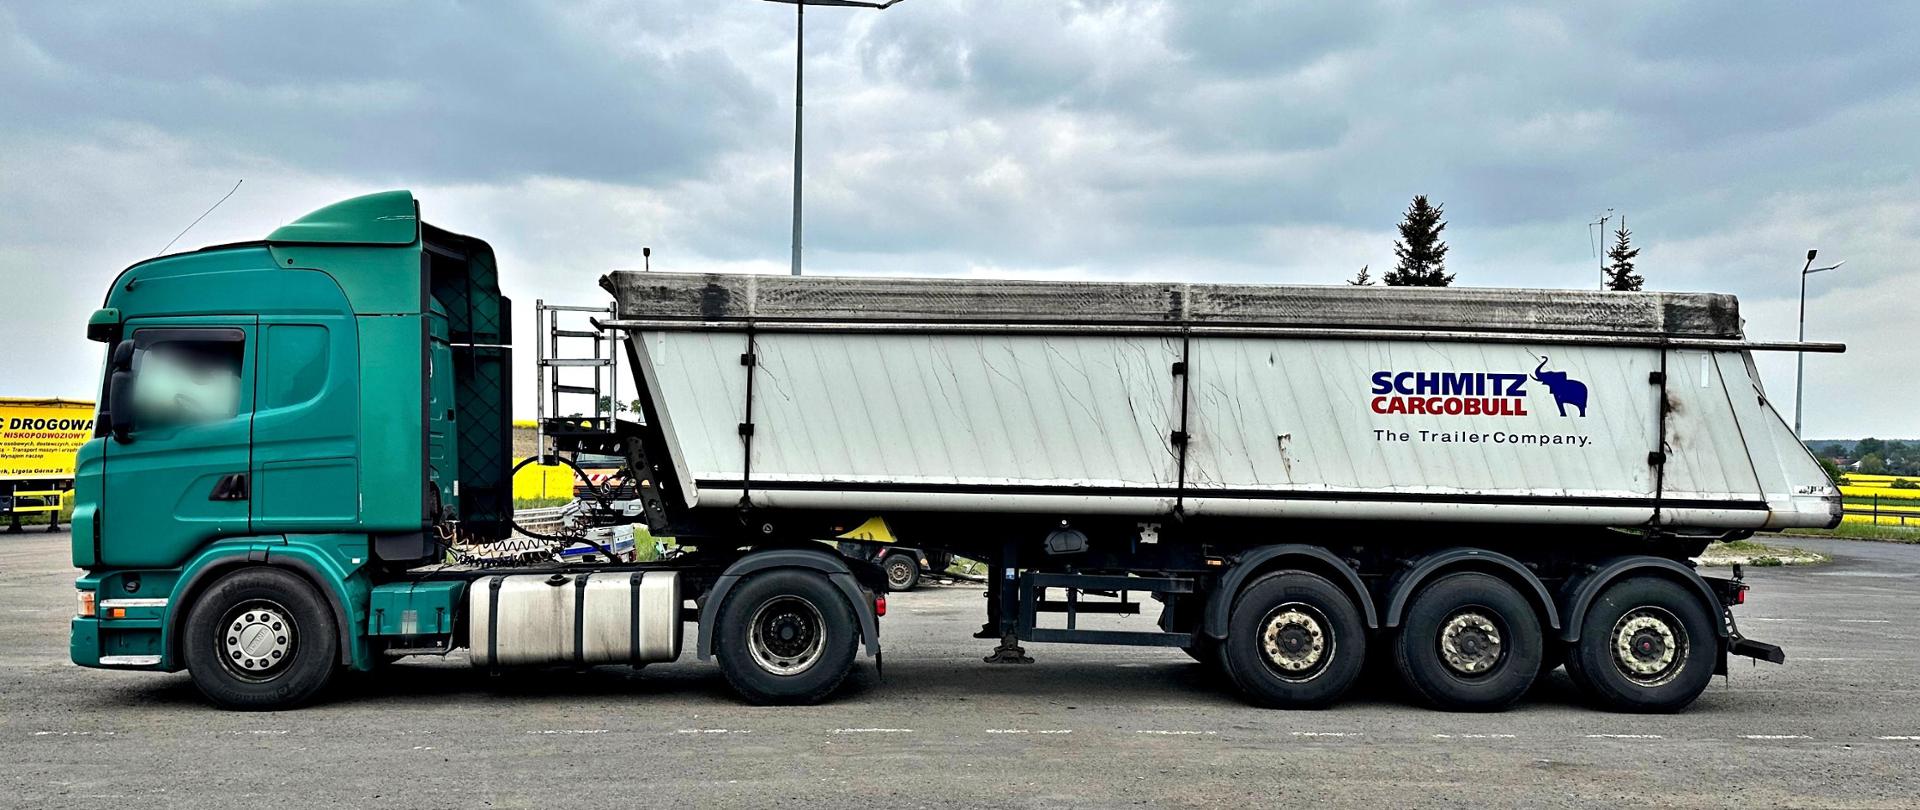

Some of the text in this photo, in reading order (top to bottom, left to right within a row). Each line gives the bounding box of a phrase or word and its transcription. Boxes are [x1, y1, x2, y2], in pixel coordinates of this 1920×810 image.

[1371, 371, 1528, 397] SCHMITZ
[1371, 396, 1528, 417] CARGOBULL
[10, 418, 93, 430] DROGOWA
[1373, 429, 1410, 443] The
